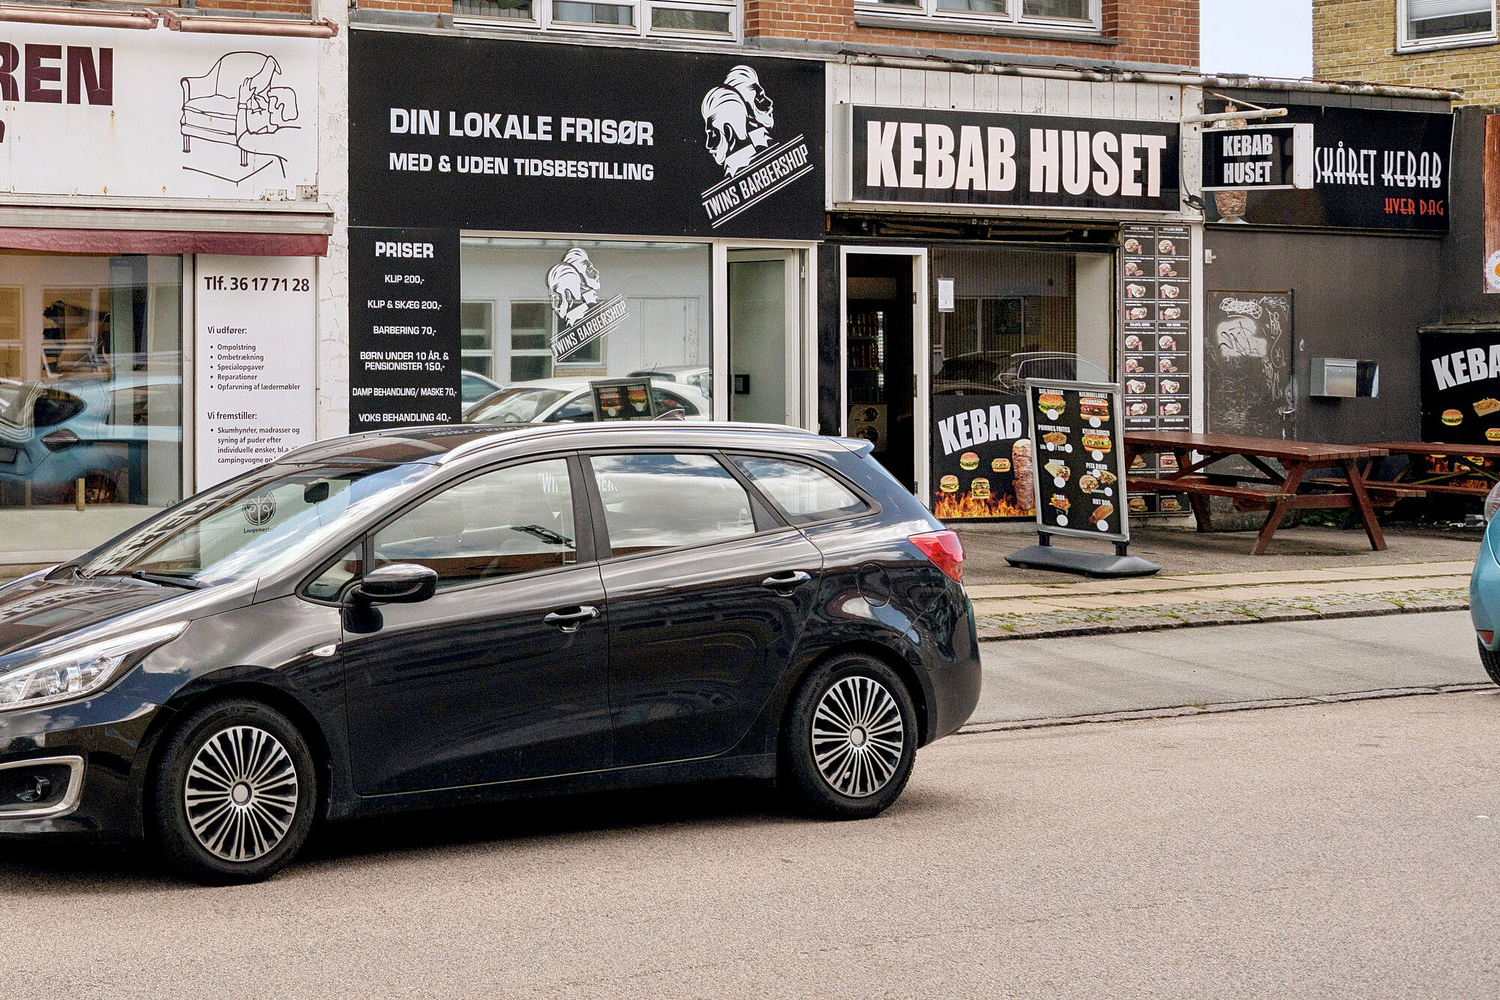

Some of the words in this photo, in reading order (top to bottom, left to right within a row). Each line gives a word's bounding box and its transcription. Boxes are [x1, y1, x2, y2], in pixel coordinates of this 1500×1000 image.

[391, 108, 439, 135] DIN
[450, 111, 552, 140] LOKALE
[561, 117, 654, 145] FRISØR
[1223, 134, 1273, 157] KEBAB
[866, 120, 1016, 191] KEBAB
[1029, 128, 1168, 197] HUSET
[390, 153, 432, 171] MED
[439, 155, 451, 172] &
[457, 156, 508, 174] UDEN
[514, 159, 654, 180] TIDSBESTILLING
[1314, 141, 1377, 186] SKÅRET
[1381, 150, 1442, 188] KEBAB
[1223, 161, 1273, 184] HUSET
[702, 186, 740, 220] TWINS
[739, 144, 808, 200] BARBERSHOP
[1384, 198, 1416, 215] HVER
[1420, 199, 1444, 216] DAG
[376, 242, 433, 258] PRISER
[204, 276, 226, 290] Tlf.
[230, 277, 248, 290] 36
[252, 278, 268, 291] 17
[272, 278, 287, 291] 71
[293, 278, 309, 291] 28
[404, 275, 424, 284] 200,-
[368, 300, 385, 308] KLIP
[395, 301, 419, 309] SKÆG
[422, 301, 441, 310] 200,-
[217, 326, 247, 334] udfører:
[374, 326, 419, 334] BARBERING
[422, 327, 436, 336] 70,-
[551, 332, 578, 356] TWINS
[576, 300, 627, 341] BARBERSHOP
[217, 344, 256, 352] Ompolstring
[217, 354, 264, 362] Ombetrækning
[386, 352, 413, 360] UNDER
[416, 352, 426, 360] 10
[428, 350, 441, 360] ÅR.
[218, 363, 264, 372] Specialopgaver
[365, 362, 422, 370] PENSIONISTER
[425, 362, 445, 371] 150,-
[218, 373, 257, 381] Reparationer
[218, 383, 252, 392] Opfarvning
[353, 388, 372, 396] DAMP
[374, 388, 419, 397] BEHANDLING/
[445, 388, 457, 396] 70,-
[383, 413, 434, 421] BEHANDLING
[436, 413, 451, 422] 40,-
[218, 427, 257, 435] Skumhynder,
[938, 404, 1022, 456] KEBAB
[218, 437, 238, 445] syning
[255, 446, 276, 454] ønsker,
[218, 456, 263, 464] campingvogne
